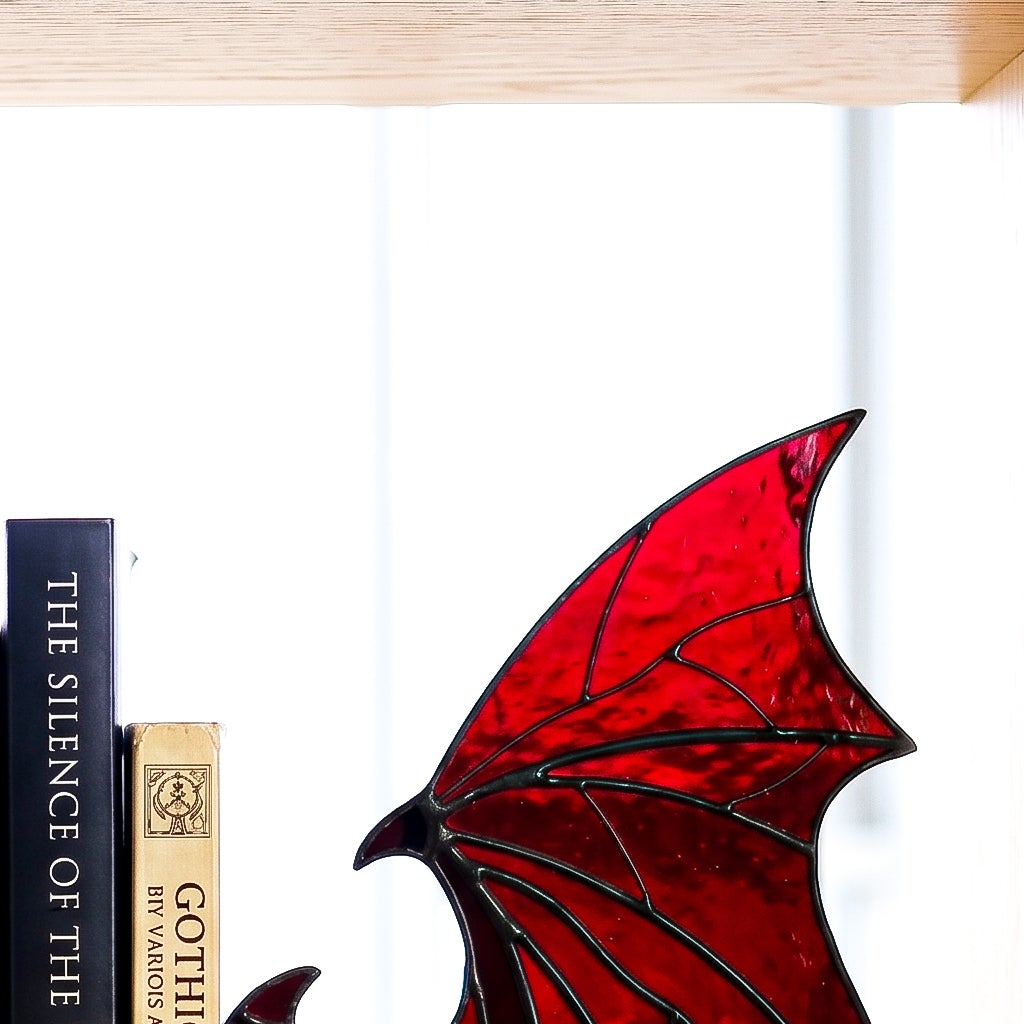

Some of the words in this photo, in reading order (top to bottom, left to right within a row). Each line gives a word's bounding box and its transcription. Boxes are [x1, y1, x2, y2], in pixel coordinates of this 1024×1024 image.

[48, 572, 78, 654] THE
[48, 674, 78, 840] SILENCE
[50, 858, 79, 908] OF
[50, 926, 79, 1006] THE
